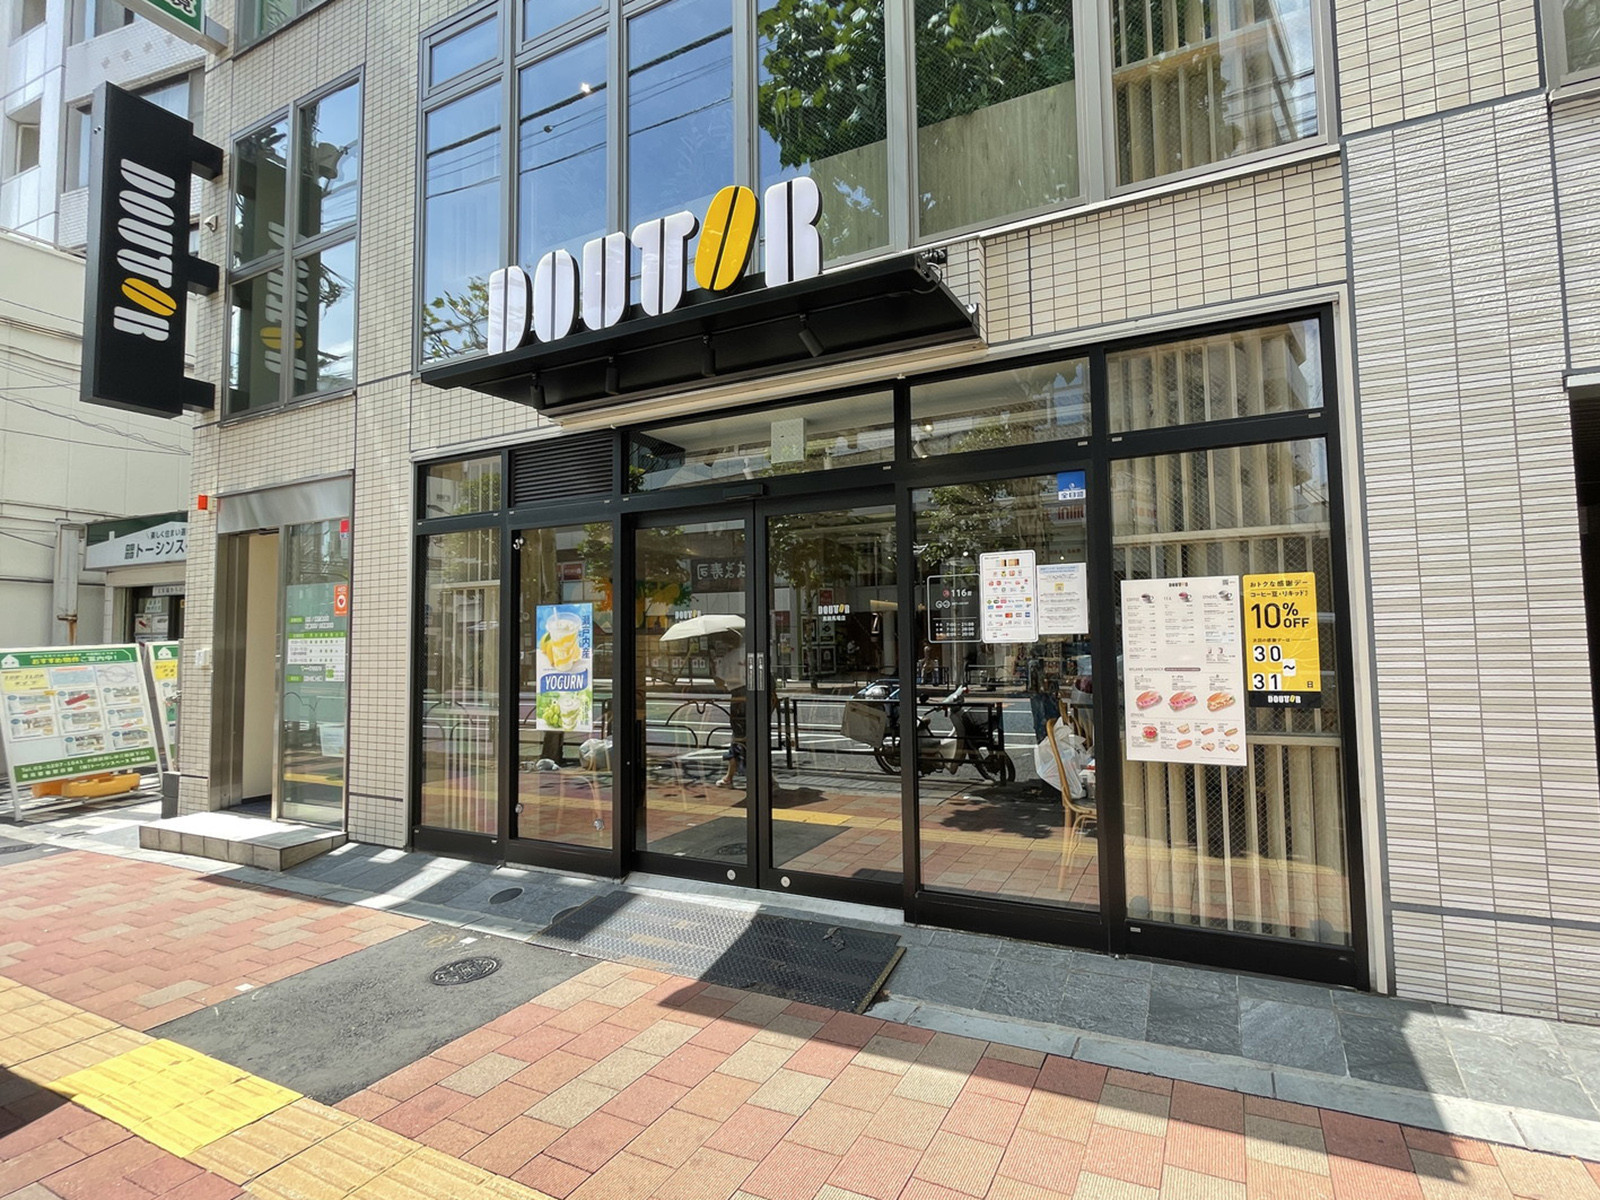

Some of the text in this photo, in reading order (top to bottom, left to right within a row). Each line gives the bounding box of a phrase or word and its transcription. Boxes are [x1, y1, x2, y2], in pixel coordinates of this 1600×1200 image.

[114, 158, 177, 341] DOUTOR
[488, 176, 822, 355] DOUTOR
[136, 540, 188, 558] トーシンス
[818, 603, 850, 614] DOUTOR
[1251, 602, 1299, 629] 10%
[1283, 617, 1310, 628] OFF
[1254, 645, 1281, 662] 30
[545, 675, 584, 690] YOGURN
[1253, 674, 1278, 690] 31
[1267, 694, 1301, 703] DOUTOR
